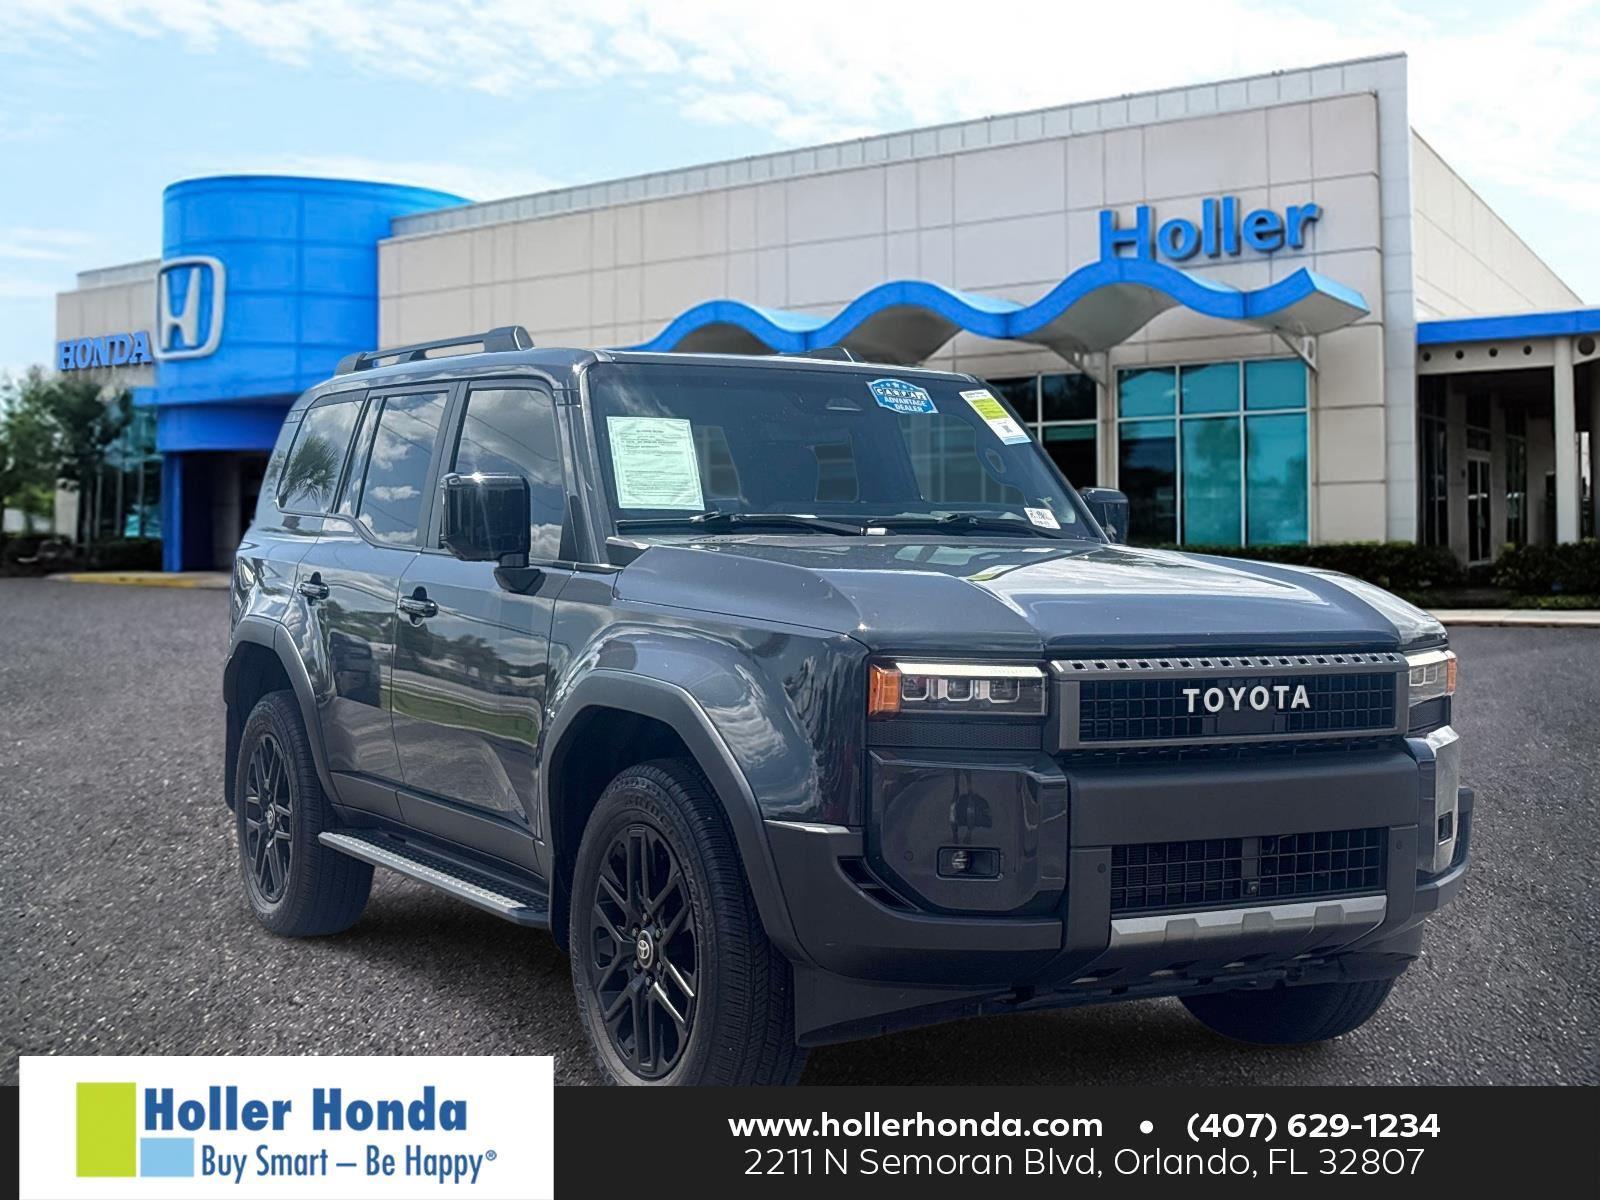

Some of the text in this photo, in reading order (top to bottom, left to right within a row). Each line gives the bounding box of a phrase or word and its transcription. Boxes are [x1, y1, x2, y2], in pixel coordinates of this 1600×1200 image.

[1099, 195, 1323, 262] Holler
[57, 331, 153, 371] HONDA
[884, 396, 928, 407] ADVANTAGE
[894, 404, 924, 413] DEALER
[1182, 685, 1310, 713] TOYOTA
